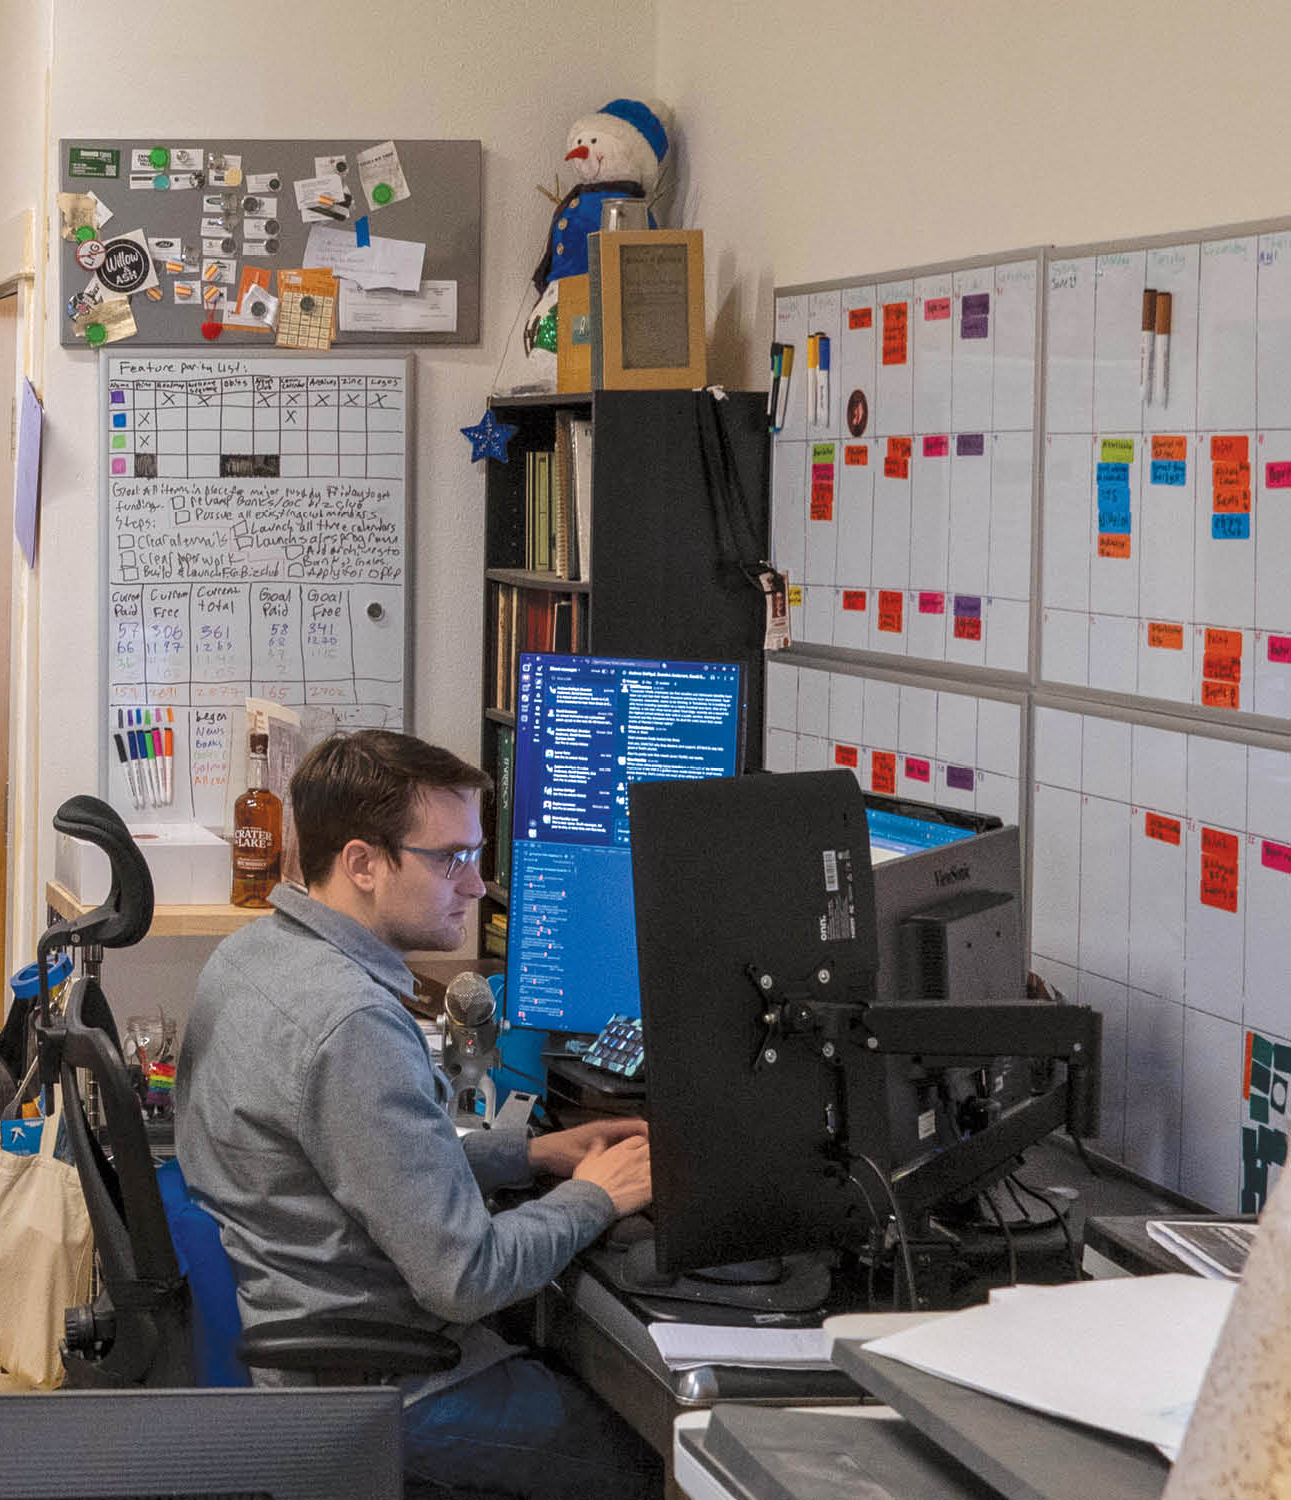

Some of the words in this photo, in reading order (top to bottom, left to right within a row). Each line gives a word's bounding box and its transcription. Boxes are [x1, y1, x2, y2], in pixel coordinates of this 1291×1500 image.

[105, 251, 139, 273] Willow
[116, 270, 137, 285] ASH
[119, 361, 176, 375] Feature
[259, 587, 291, 603] Goal
[307, 588, 342, 604] Goal
[114, 603, 138, 618] Paid
[262, 602, 289, 617] Paid
[235, 829, 273, 841] CRATER
[238, 839, 267, 848] LAKE
